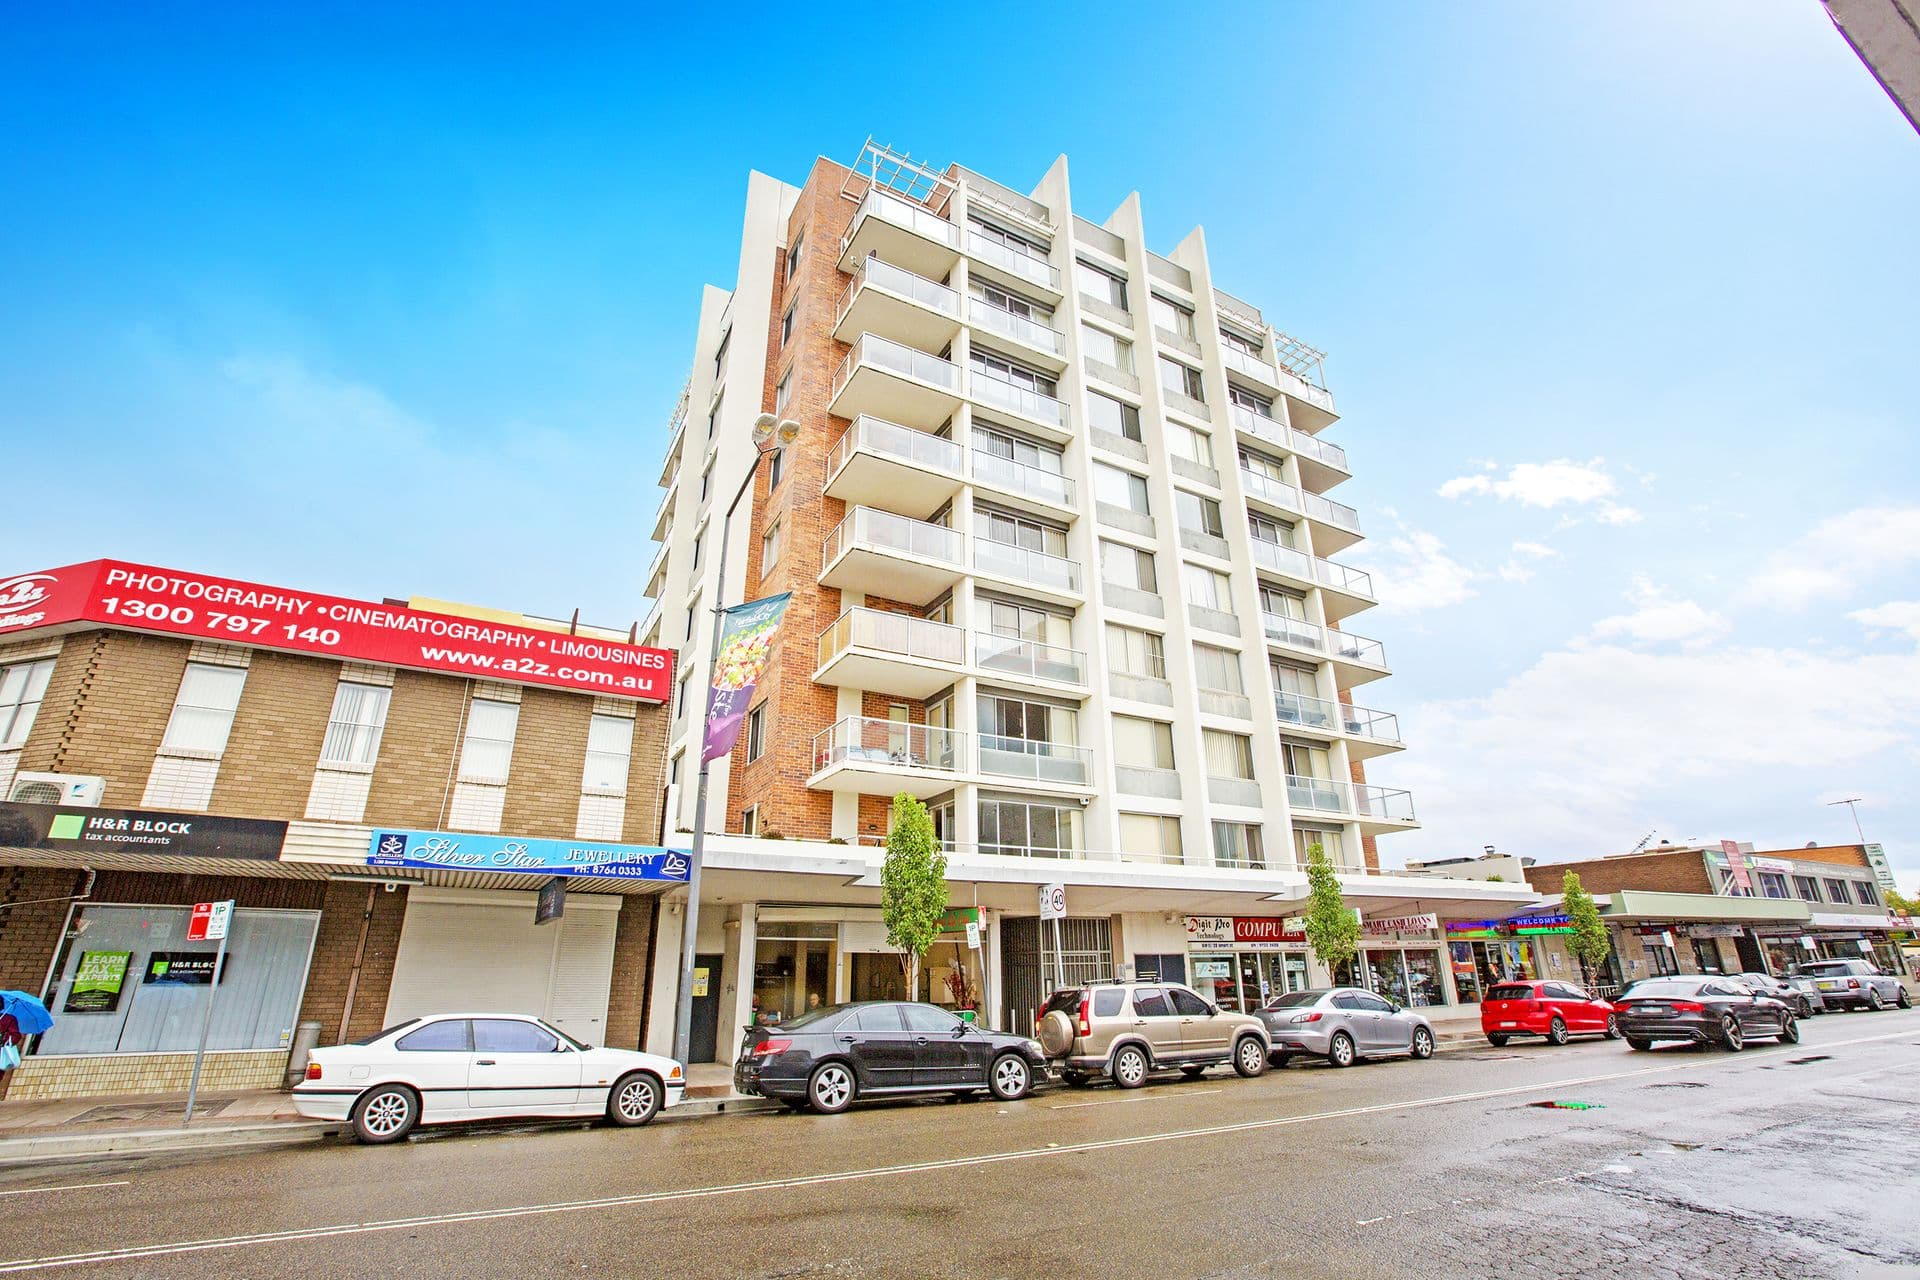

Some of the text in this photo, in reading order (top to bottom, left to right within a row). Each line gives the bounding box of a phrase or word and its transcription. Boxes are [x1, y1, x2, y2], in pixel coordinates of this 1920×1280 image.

[101, 598, 340, 646] 1300 797 140
[106, 569, 665, 669] PHOTOGRAPHY CINEMATOGRAPHY LIMOUSINES
[420, 646, 653, 691] www.a2z.com.au
[89, 817, 192, 834] H&R BLOCK
[85, 832, 170, 845] tax accountants
[411, 838, 546, 868] Silver Star
[564, 849, 655, 865] JEWELLERY
[574, 865, 642, 876] PH: 8764 0333
[1054, 894, 1063, 905] 40
[1187, 918, 1231, 932] Digit Pro
[1362, 919, 1386, 929] SMART
[1516, 916, 1557, 926] WELCOME
[1196, 932, 1224, 940] Technology
[86, 955, 127, 964] LEARN
[192, 961, 217, 969] BLOC
[83, 964, 110, 974] TAX
